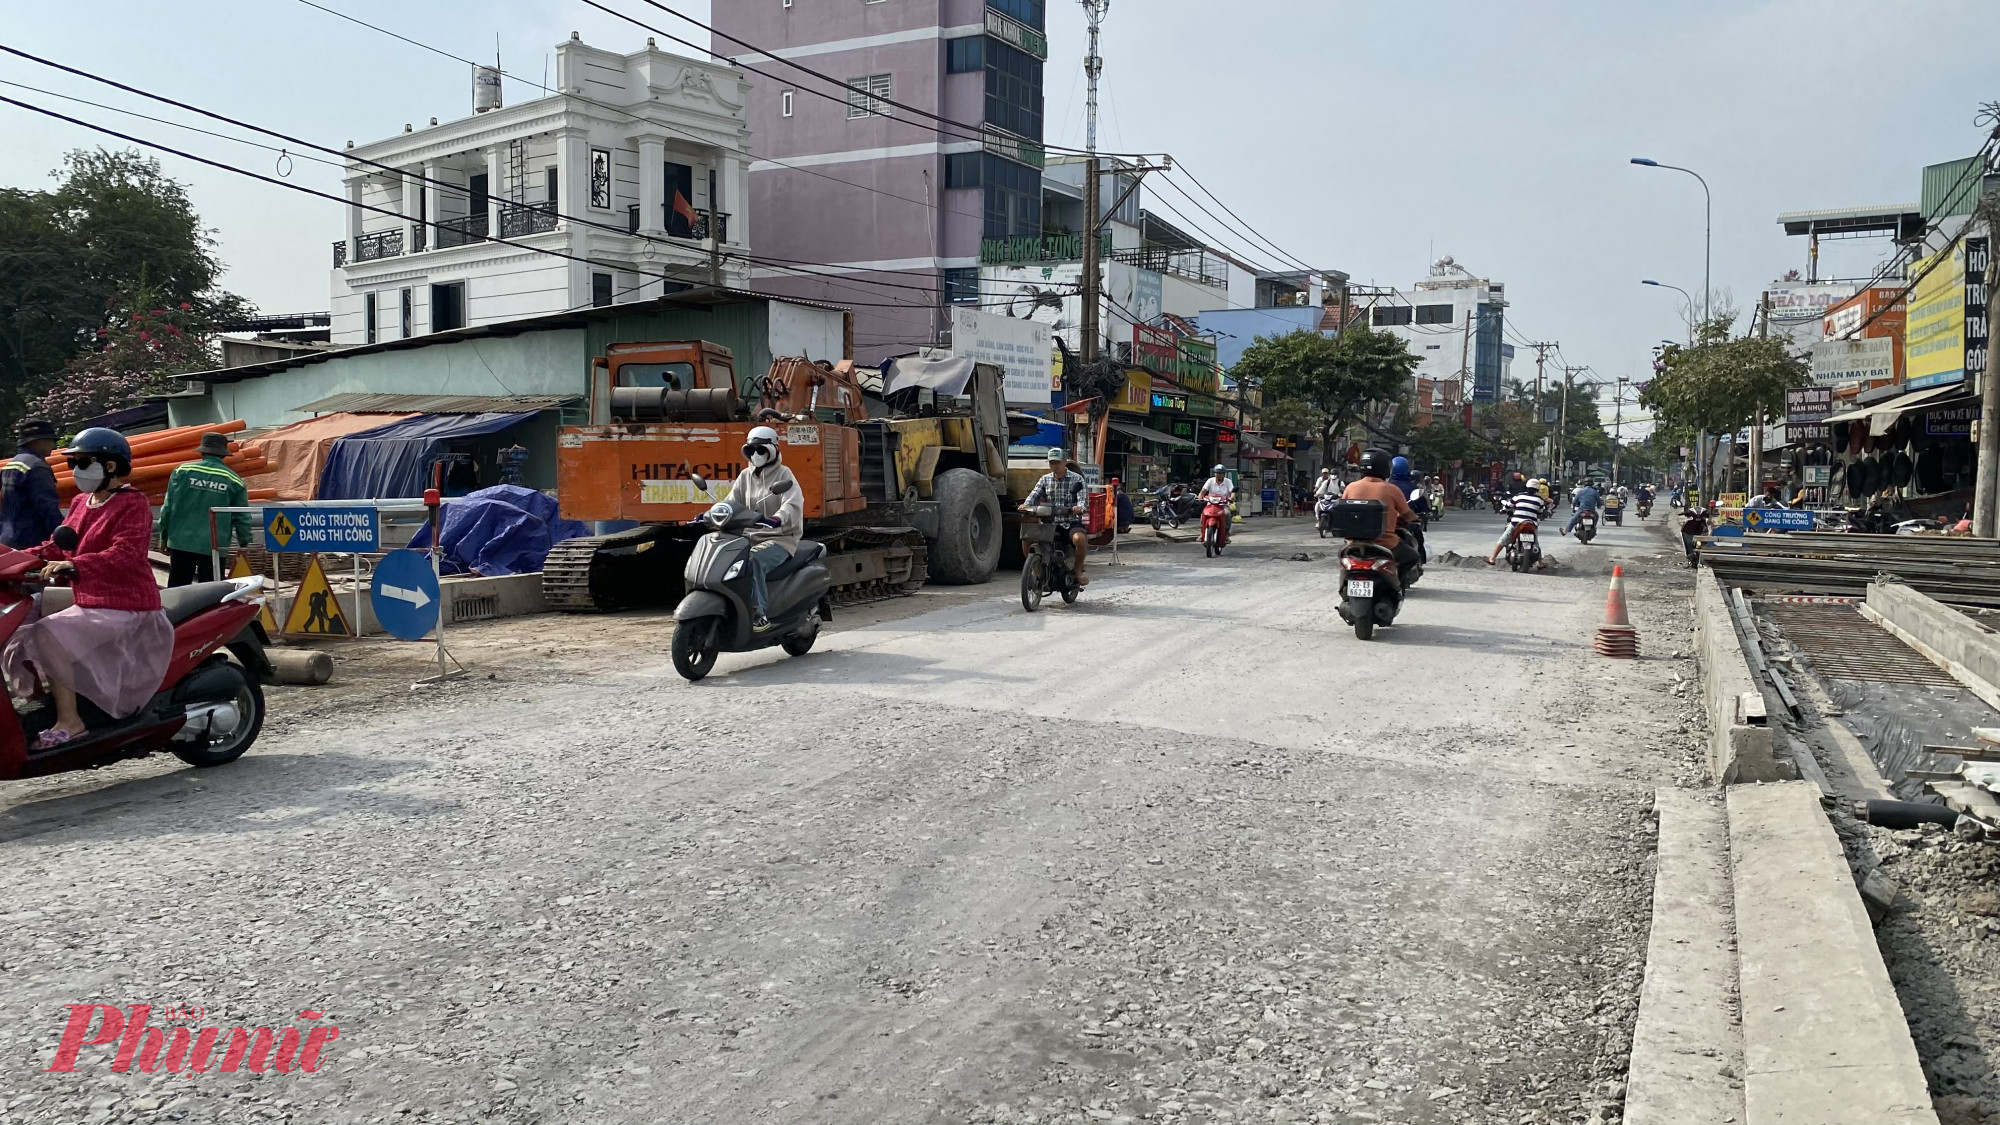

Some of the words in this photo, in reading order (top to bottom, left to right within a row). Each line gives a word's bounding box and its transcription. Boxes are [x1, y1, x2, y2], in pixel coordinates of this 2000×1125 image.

[981, 240, 1004, 263] NHA
[1966, 310, 1988, 338] TRẢ
[1850, 356, 1891, 369] SOFA
[1788, 427, 1803, 443] BỌC
[1803, 424, 1819, 439] YÊN
[1819, 426, 1830, 438] XE
[631, 462, 740, 481] HITACHI
[189, 477, 228, 491] TAYHO
[298, 512, 326, 527] CÔNG
[328, 512, 370, 527] TRƯỜNG
[1782, 512, 1808, 520] TRƯỜNG
[1791, 518, 1809, 526] CÔNG
[298, 529, 326, 542] ĐANG
[328, 529, 343, 541] THI
[344, 527, 373, 542] CÔNG
